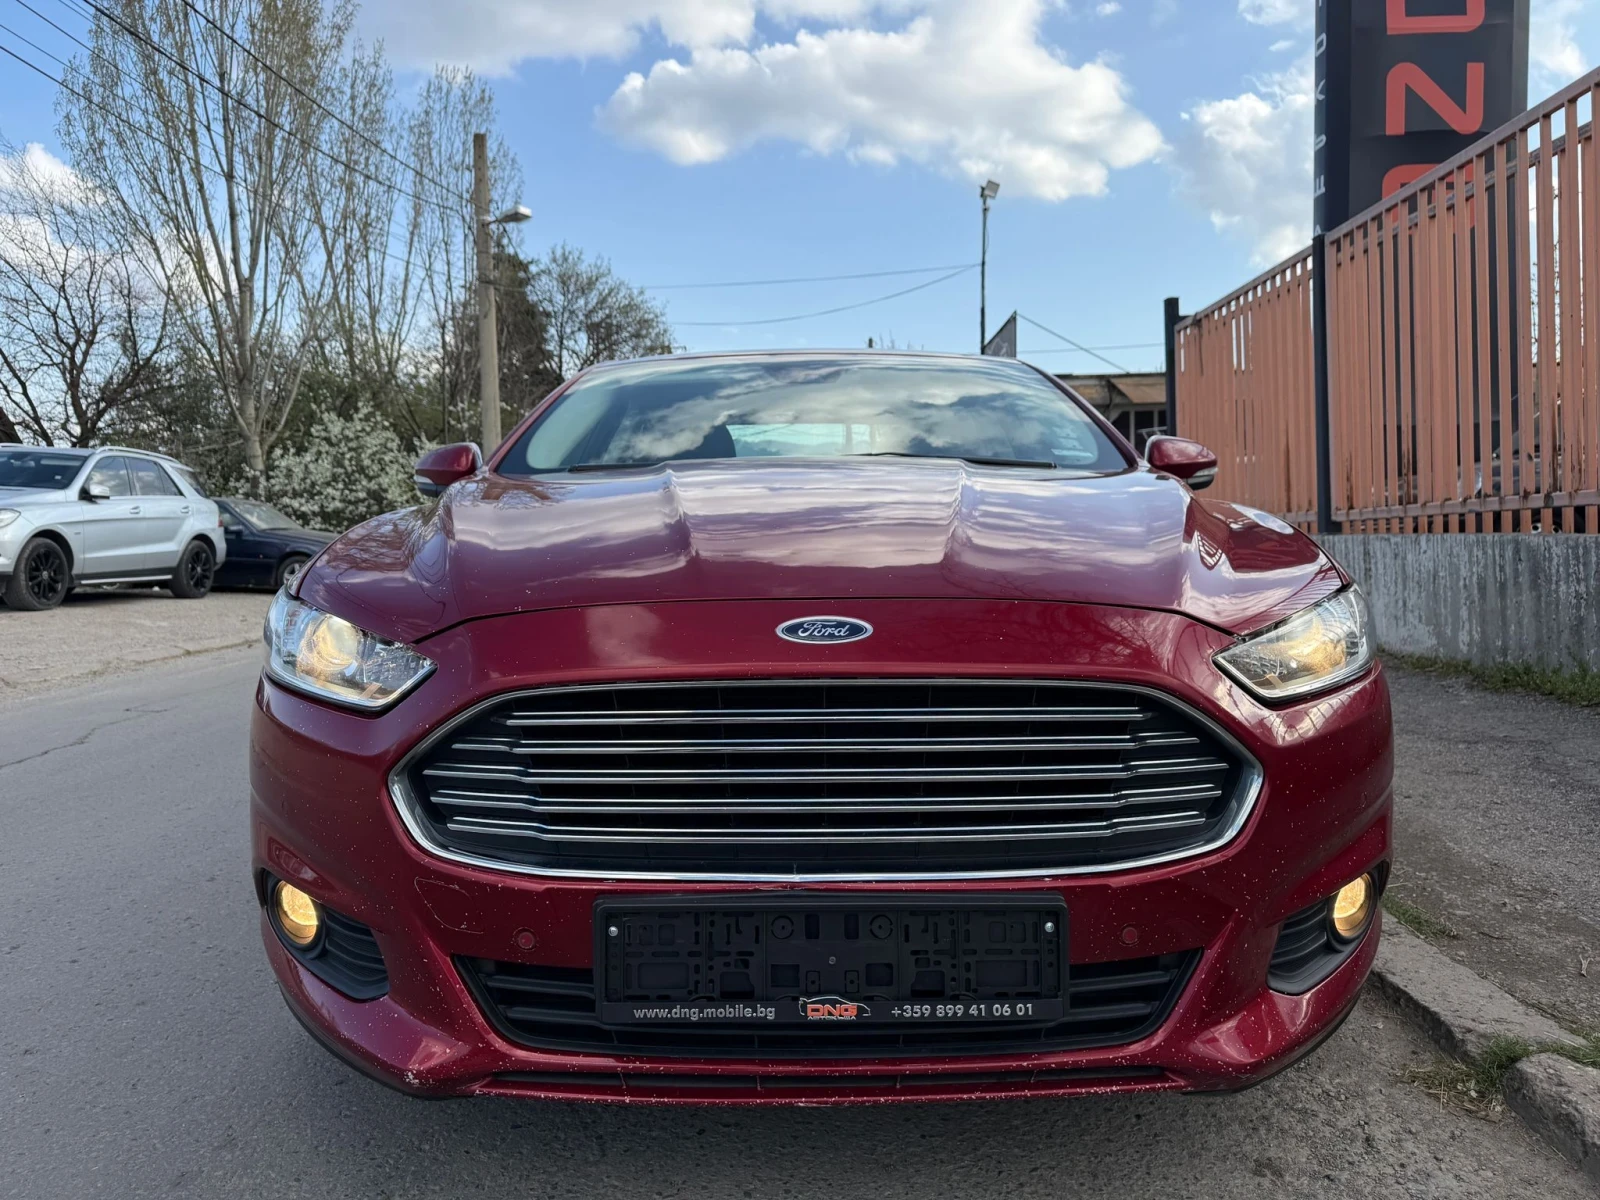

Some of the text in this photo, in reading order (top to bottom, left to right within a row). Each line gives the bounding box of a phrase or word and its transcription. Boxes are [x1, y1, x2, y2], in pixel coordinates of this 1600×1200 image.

[797, 621, 850, 637] Ford
[633, 1004, 775, 1021] www.dng.mobile.bg
[807, 1004, 858, 1017] DNG
[891, 1003, 1033, 1018] +359 899 41 06 01
